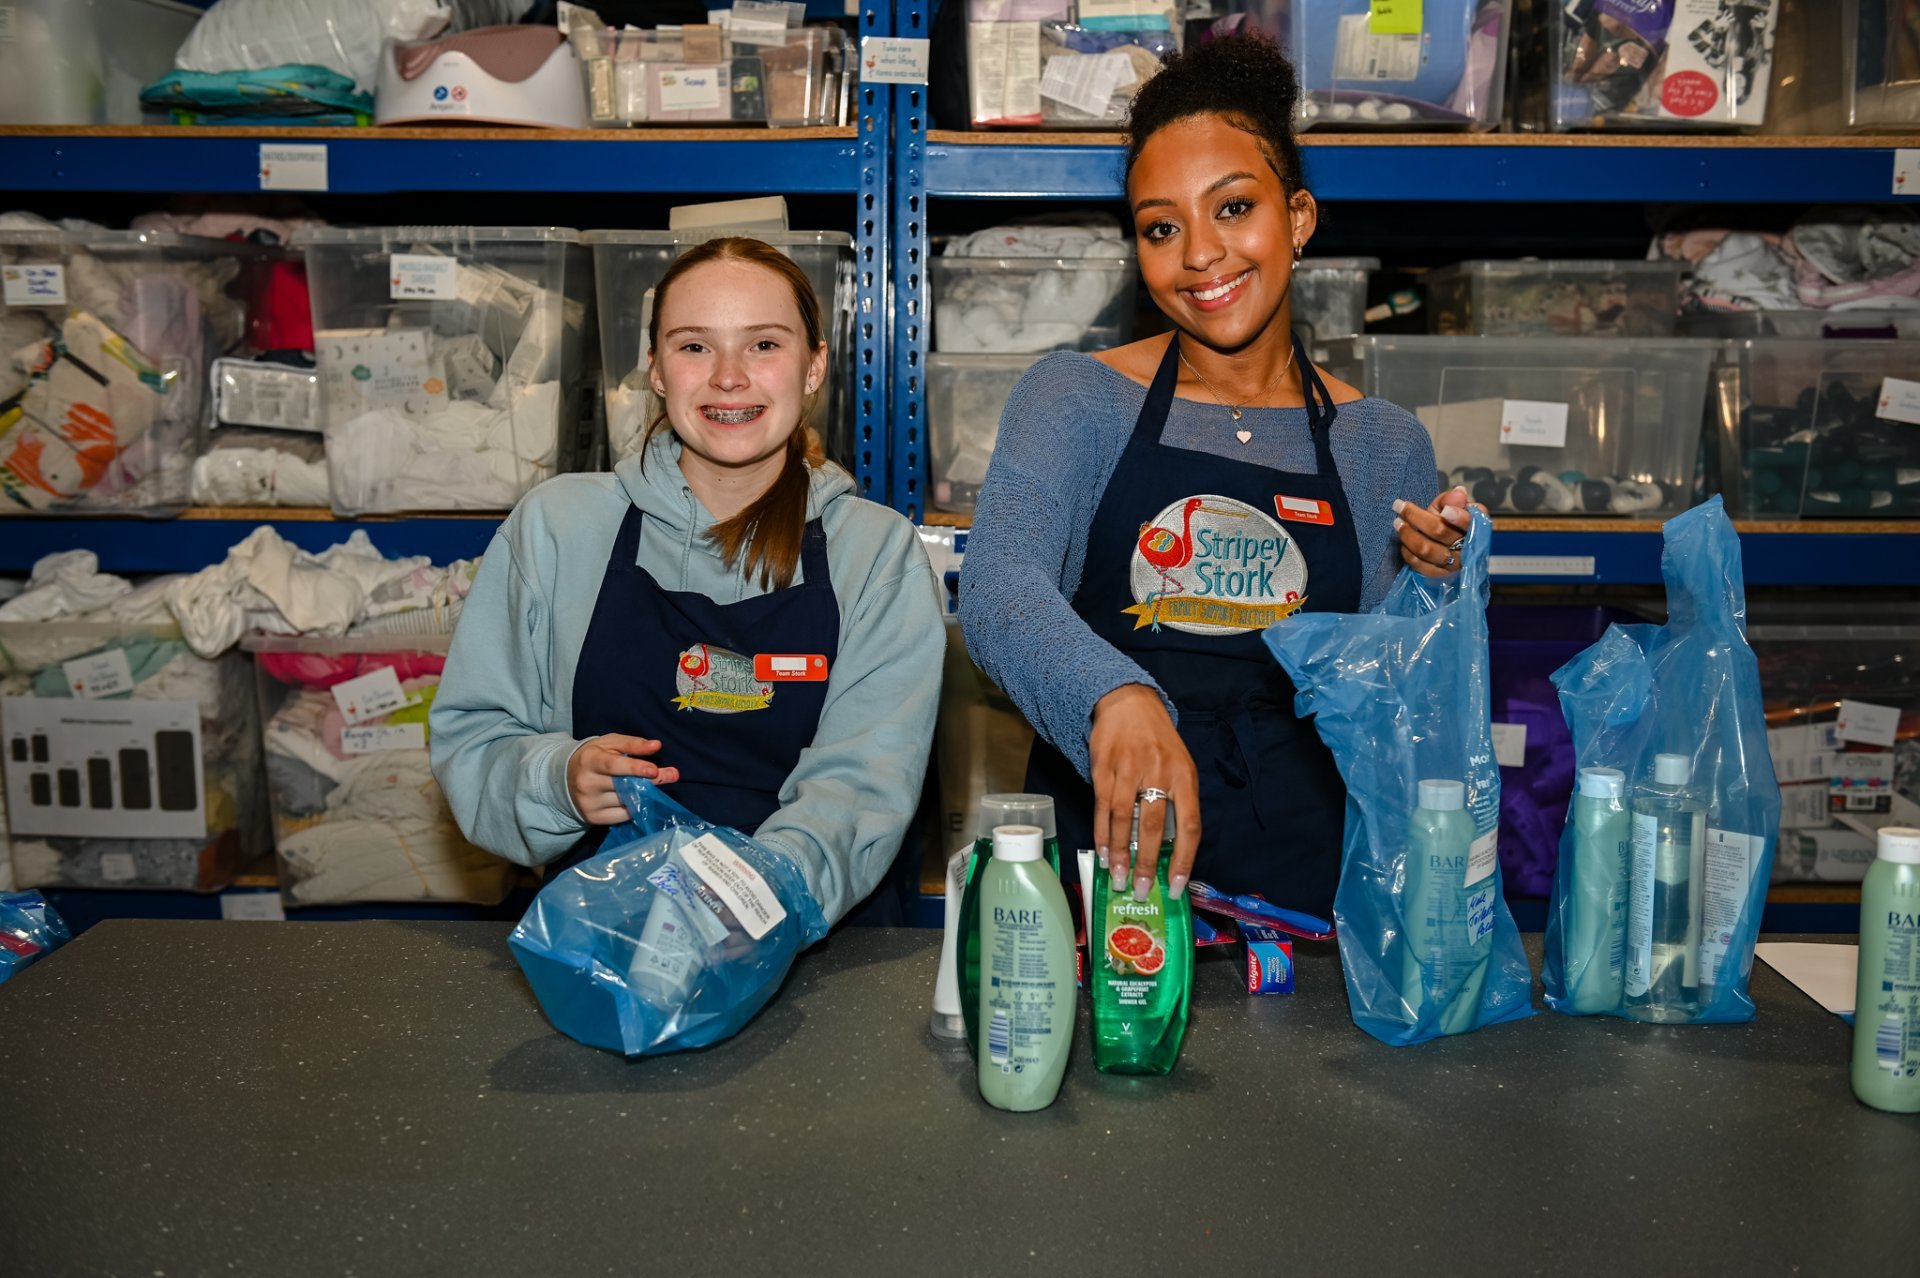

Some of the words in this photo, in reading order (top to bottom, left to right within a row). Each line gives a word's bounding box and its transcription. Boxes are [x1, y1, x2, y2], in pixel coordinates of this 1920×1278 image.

[1195, 529, 1288, 568] Stripey
[1194, 562, 1275, 597] Stork
[711, 671, 754, 693] Stork
[1430, 855, 1466, 868] BAR
[706, 850, 715, 859] BAG
[720, 861, 729, 869] NOT
[755, 899, 770, 919] DANGER
[734, 882, 743, 891] OUT
[994, 907, 1042, 925] BARE
[1113, 903, 1159, 916] refresh
[1250, 955, 1259, 989] Colgate
